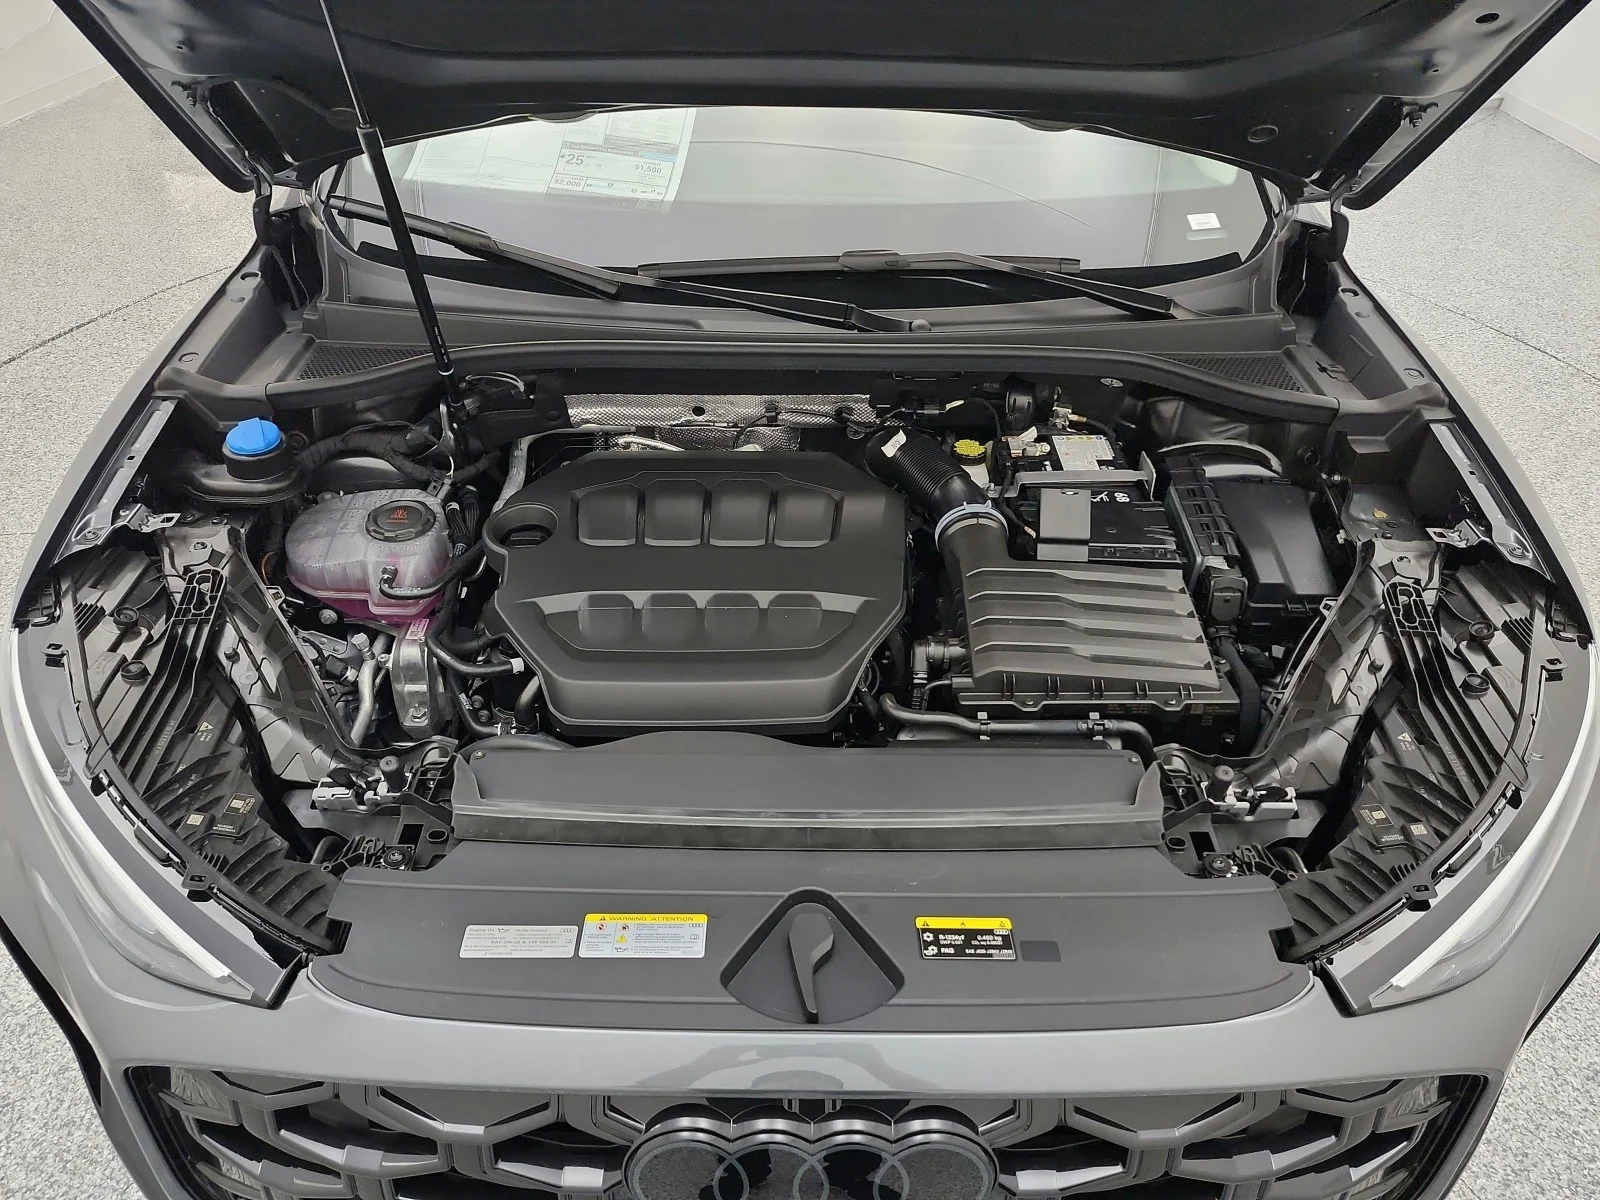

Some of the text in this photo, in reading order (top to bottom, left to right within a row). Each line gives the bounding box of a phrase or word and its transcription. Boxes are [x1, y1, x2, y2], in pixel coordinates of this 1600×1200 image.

[565, 153, 585, 166] 25
[634, 164, 662, 174] $1,500
[553, 179, 581, 188] $2,000
